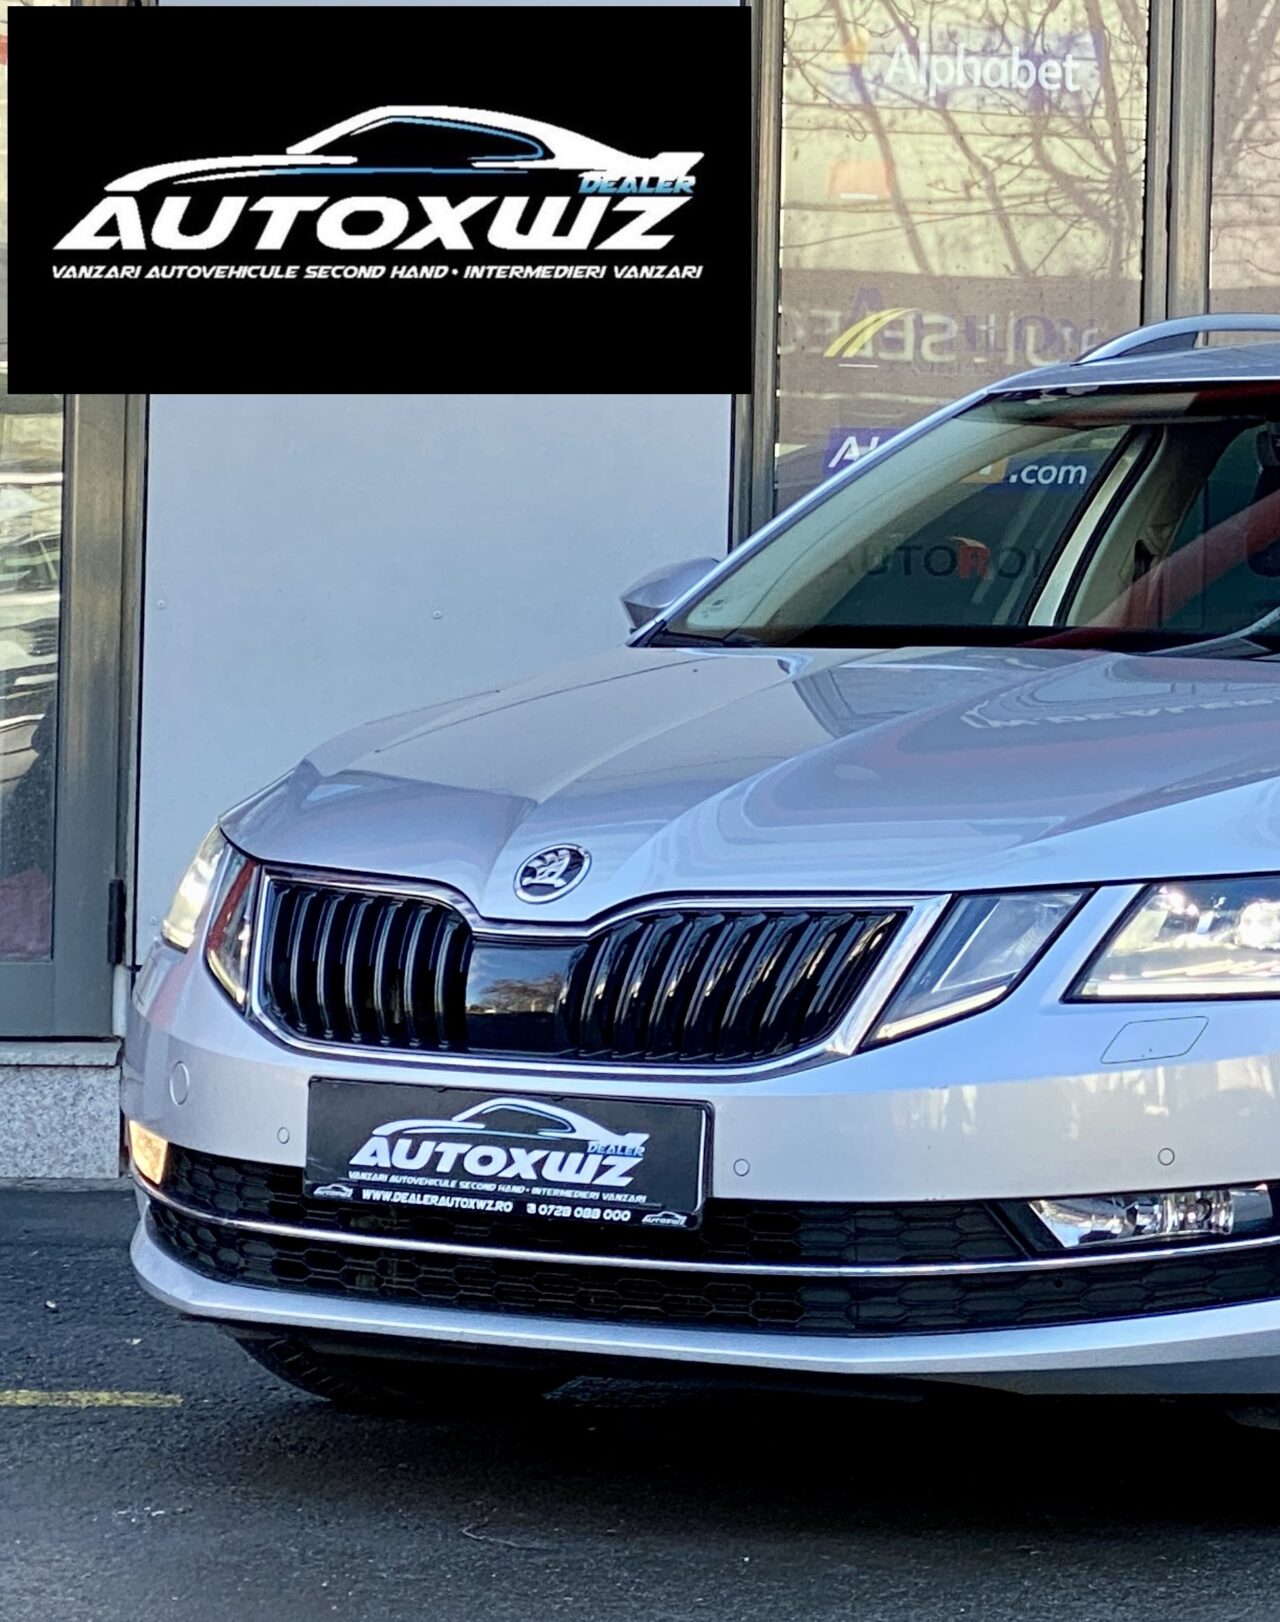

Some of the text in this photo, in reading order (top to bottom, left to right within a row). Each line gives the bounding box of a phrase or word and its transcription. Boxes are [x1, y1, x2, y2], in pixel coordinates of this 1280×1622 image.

[883, 41, 1081, 97] Alphabet
[1009, 464, 1088, 485] .com
[349, 1136, 644, 1187] AUTOXWZ
[587, 1141, 645, 1157] DEALER
[349, 1171, 648, 1203] VANZARI AUTOVEHICULE SECOND HAND INTERMEDIERI VANZARI
[362, 1189, 514, 1213] WWW.DEALERAUTOXWZ.RO
